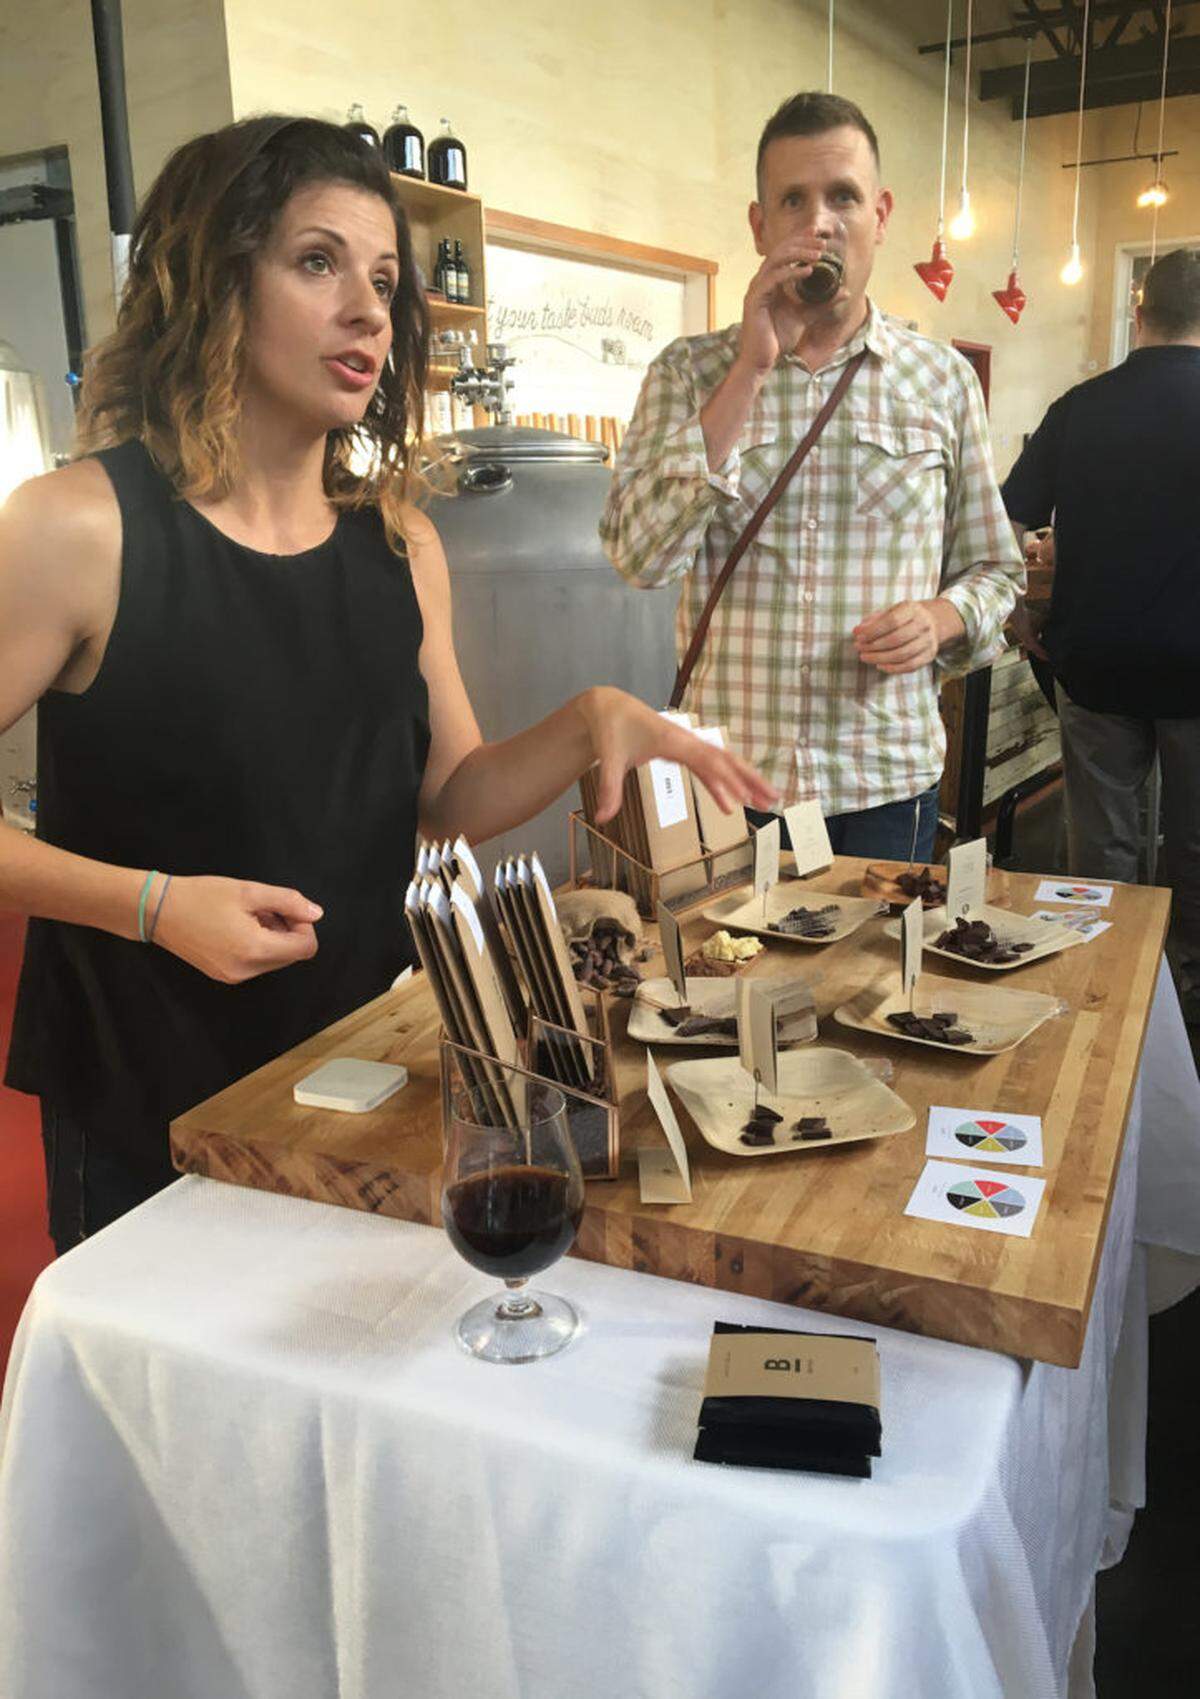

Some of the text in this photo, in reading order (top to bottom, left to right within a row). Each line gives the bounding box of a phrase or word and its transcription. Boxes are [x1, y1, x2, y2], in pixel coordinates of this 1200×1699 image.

[495, 305, 540, 339] your
[541, 299, 578, 331] taste
[578, 295, 614, 329] buds
